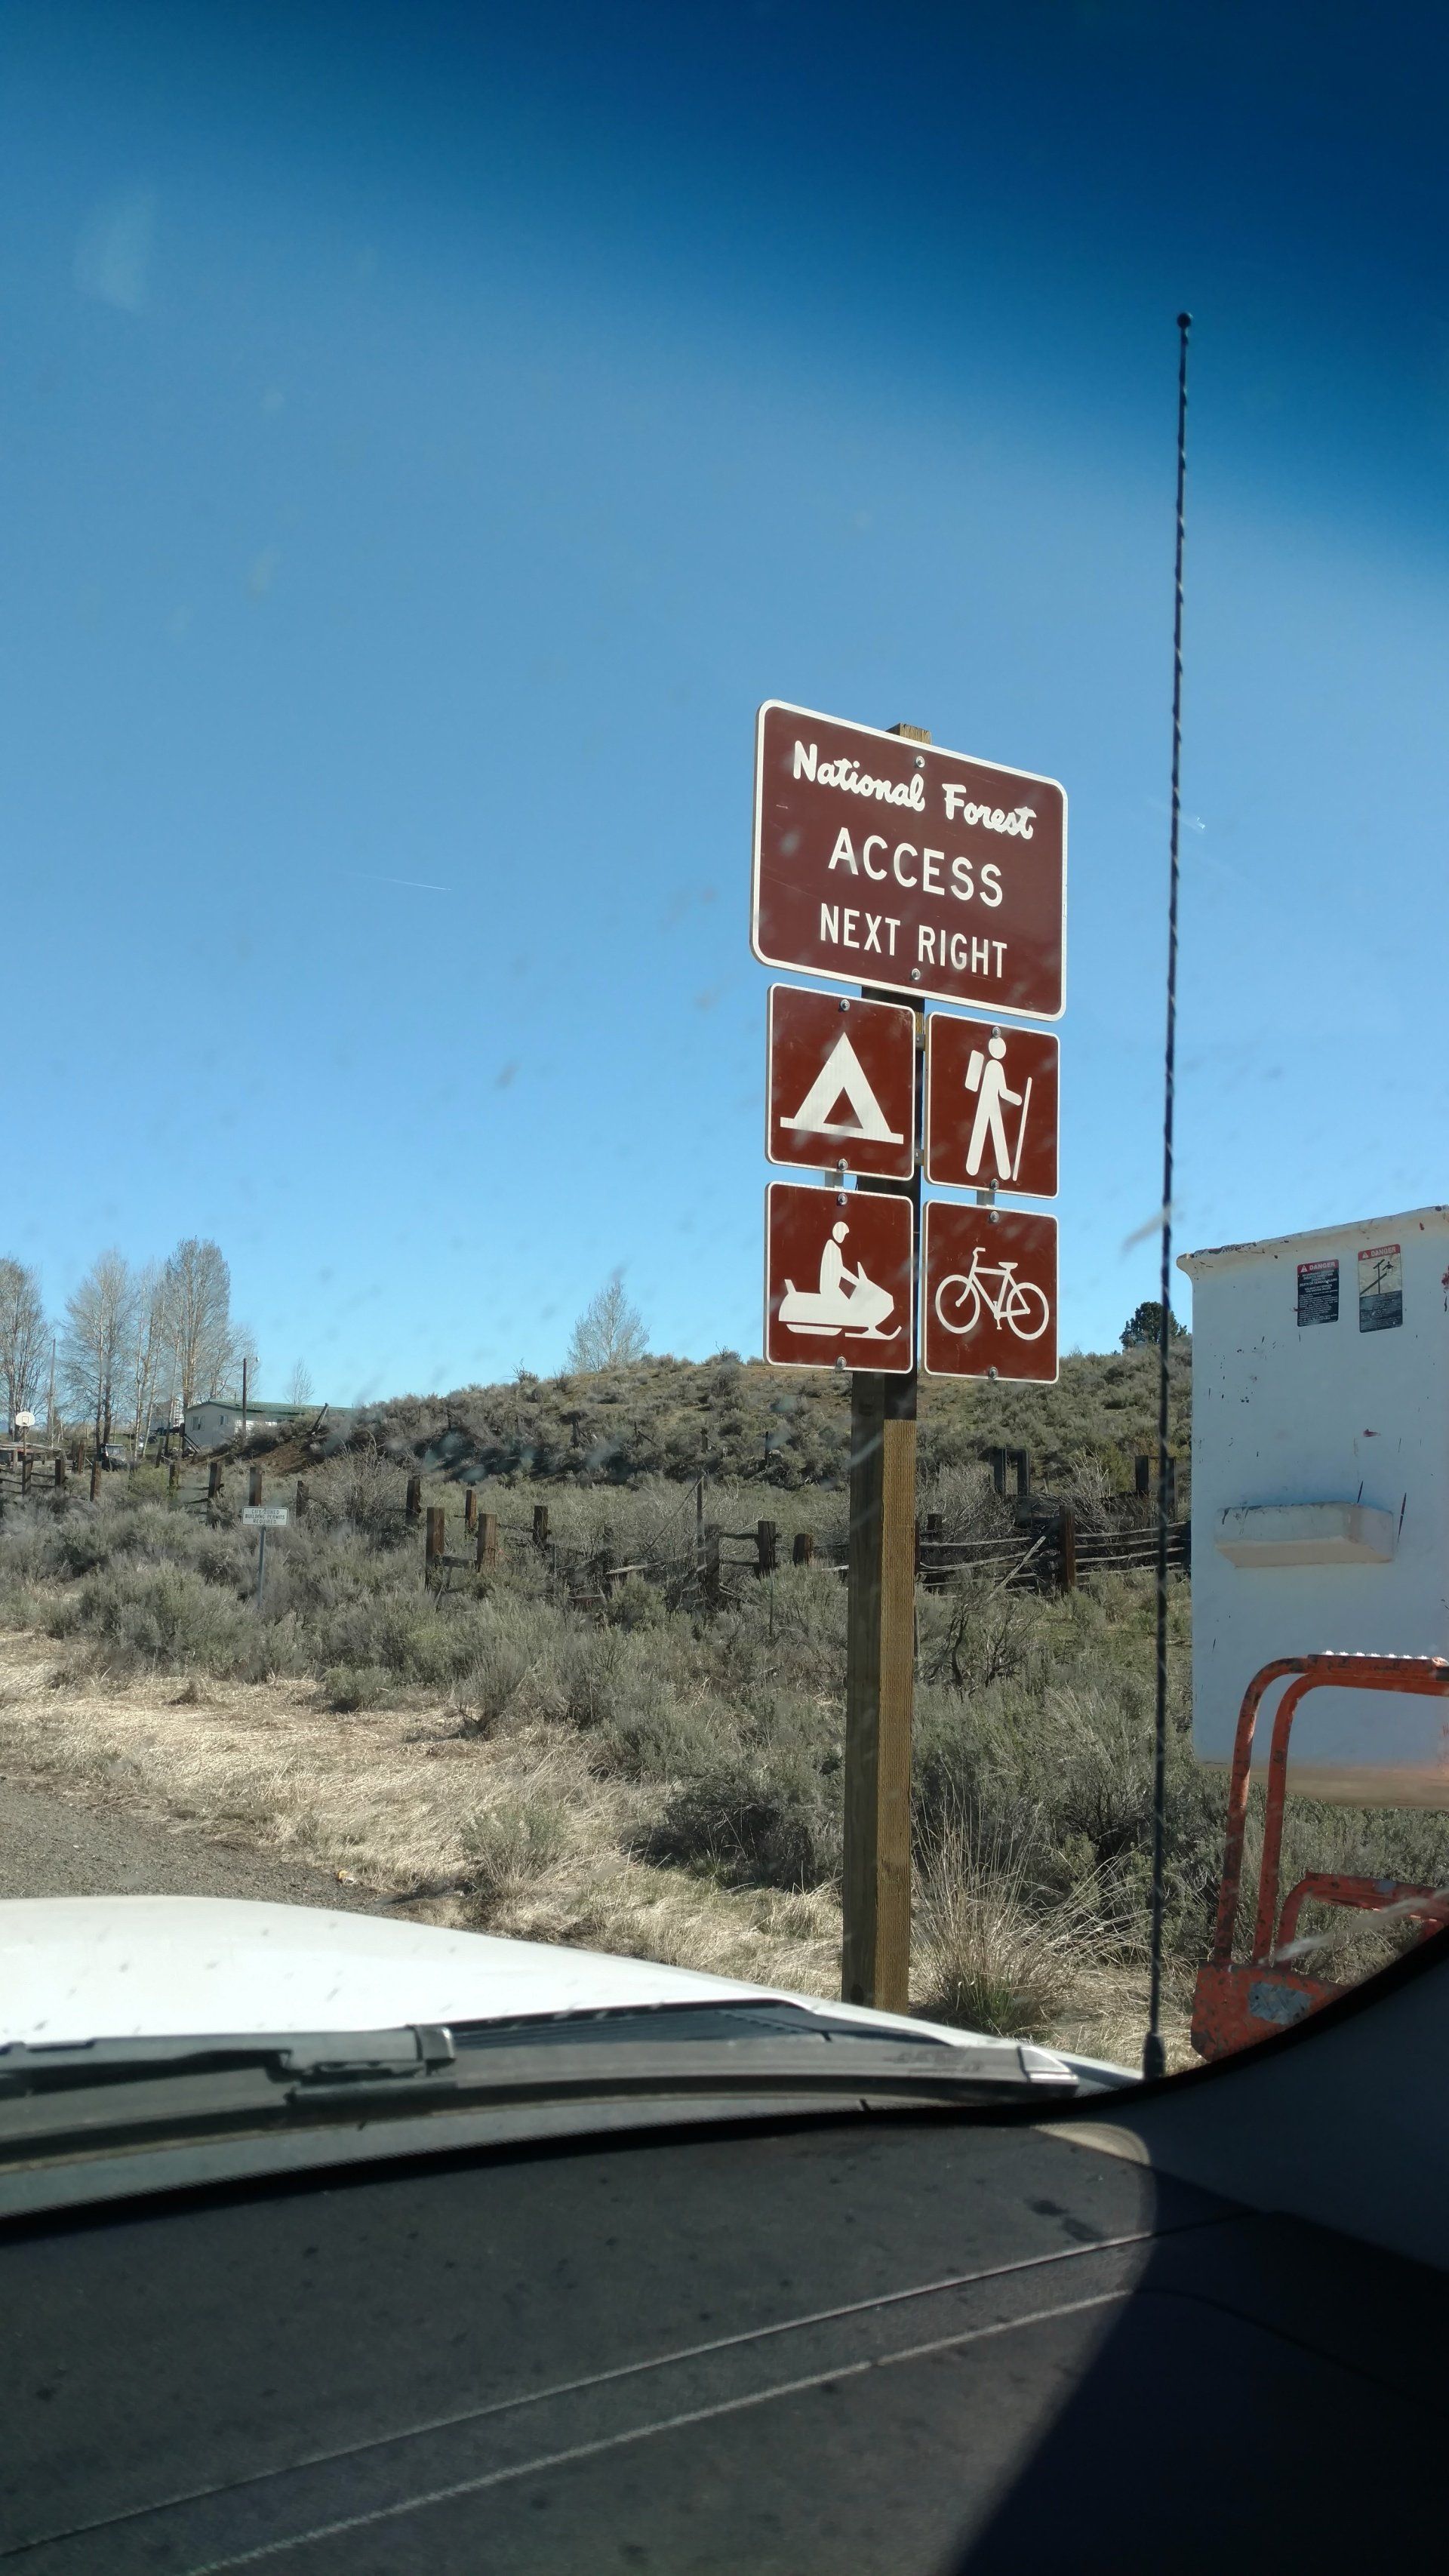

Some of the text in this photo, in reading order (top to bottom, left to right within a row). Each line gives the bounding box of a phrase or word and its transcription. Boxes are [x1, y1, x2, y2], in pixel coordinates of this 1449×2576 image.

[792, 740, 1038, 840] National Forest
[827, 826, 1003, 907] ACCESS
[820, 903, 1008, 978] NEXT RIGHT
[1309, 1261, 1335, 1271] DANGER
[1371, 1246, 1396, 1257] DANGER
